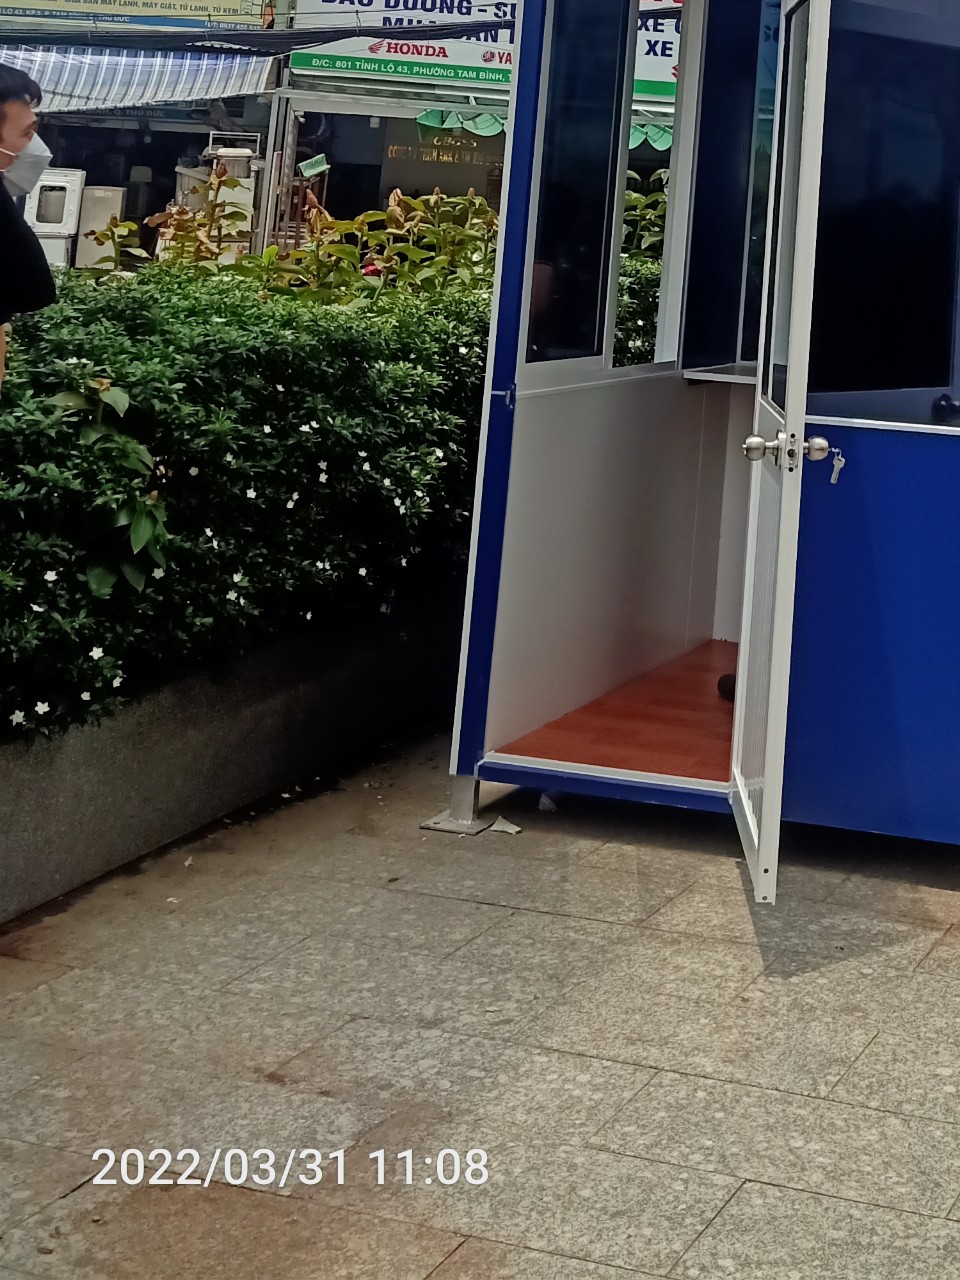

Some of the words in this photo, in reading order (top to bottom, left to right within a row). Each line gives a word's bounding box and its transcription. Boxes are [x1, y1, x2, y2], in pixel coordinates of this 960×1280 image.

[386, 41, 449, 58] HONDA
[644, 39, 674, 58] XE
[311, 58, 333, 68] Đ/C:
[335, 60, 352, 69] 801
[355, 60, 379, 71] TỈNH
[381, 62, 395, 73] LỘ
[396, 65, 411, 75] 43,
[413, 66, 455, 77] PHƯỜNG
[457, 70, 477, 79] TAM
[479, 70, 505, 81] BÌNH,
